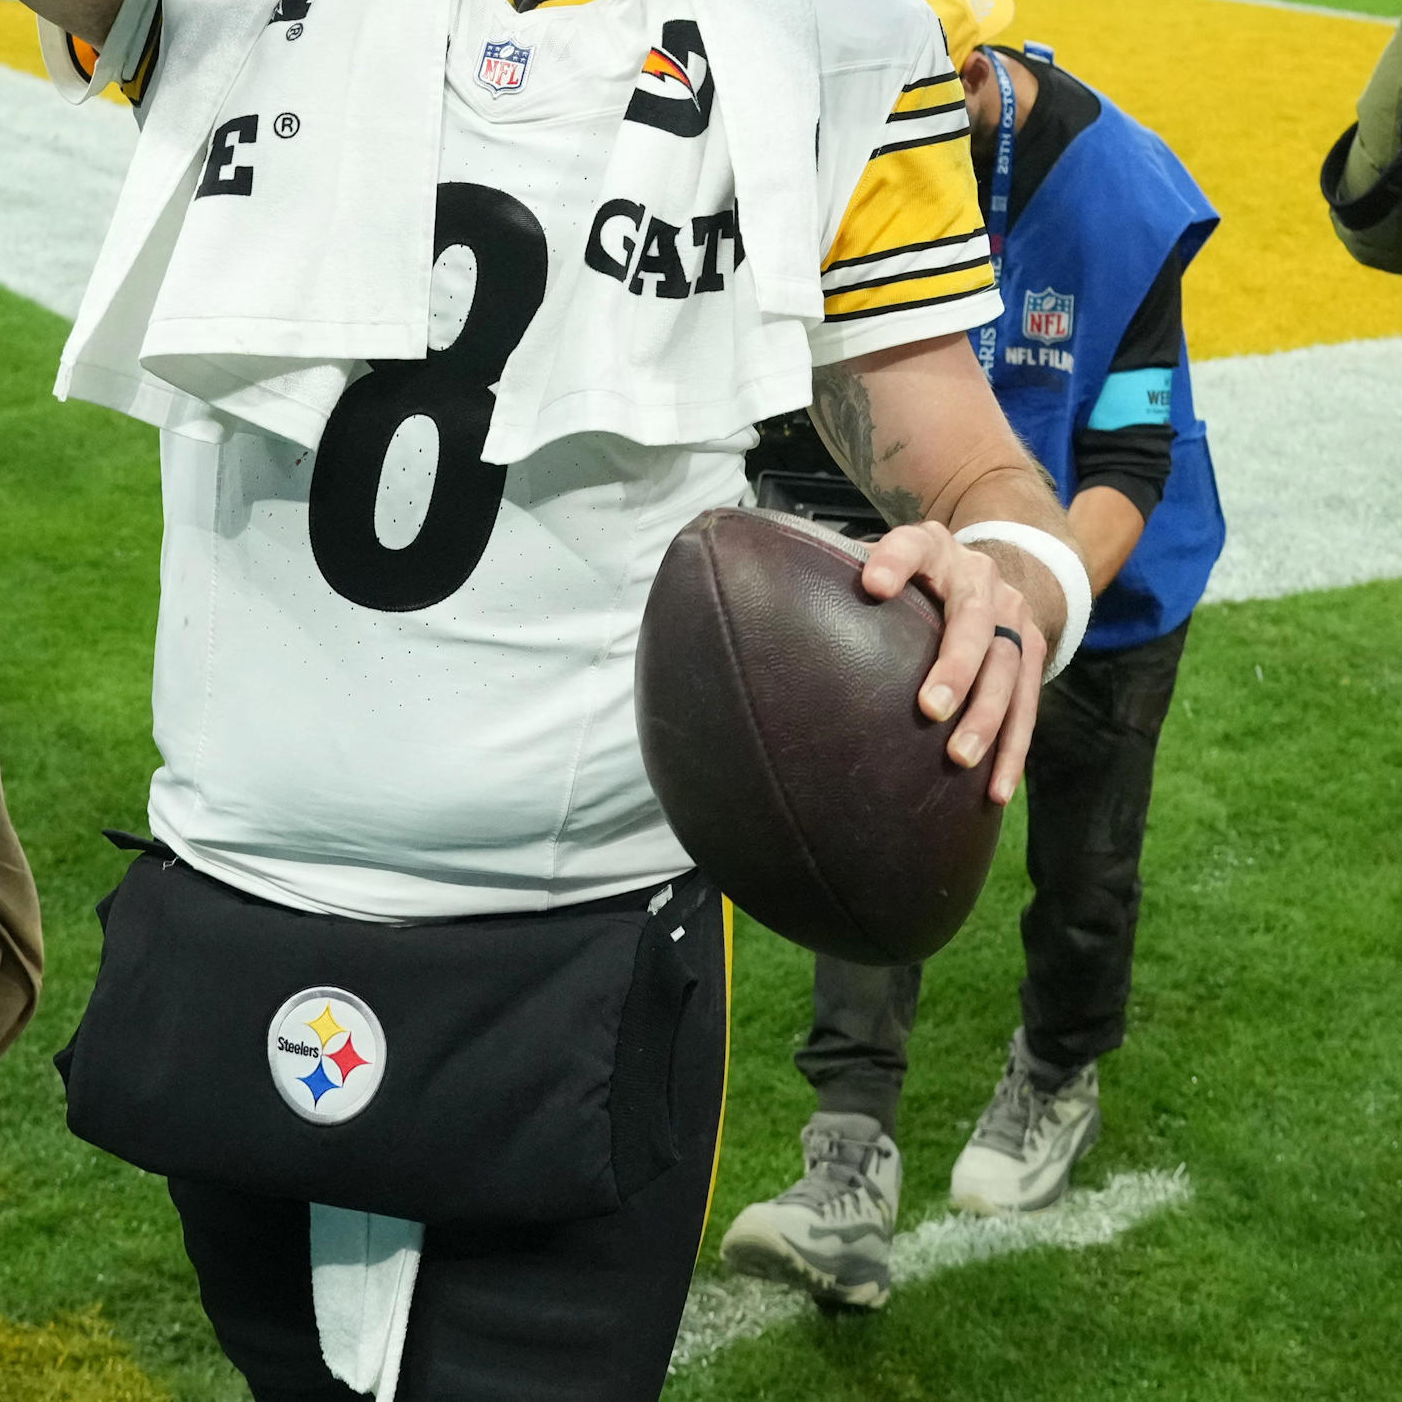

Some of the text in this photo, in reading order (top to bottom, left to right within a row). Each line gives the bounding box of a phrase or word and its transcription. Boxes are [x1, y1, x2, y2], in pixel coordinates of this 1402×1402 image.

[482, 59, 520, 86] NFL
[584, 198, 746, 299] GAT
[1028, 313, 1067, 335] NFL
[1005, 346, 1036, 367] NFL
[309, 182, 548, 613] 8
[277, 1035, 320, 1059] Steelers
